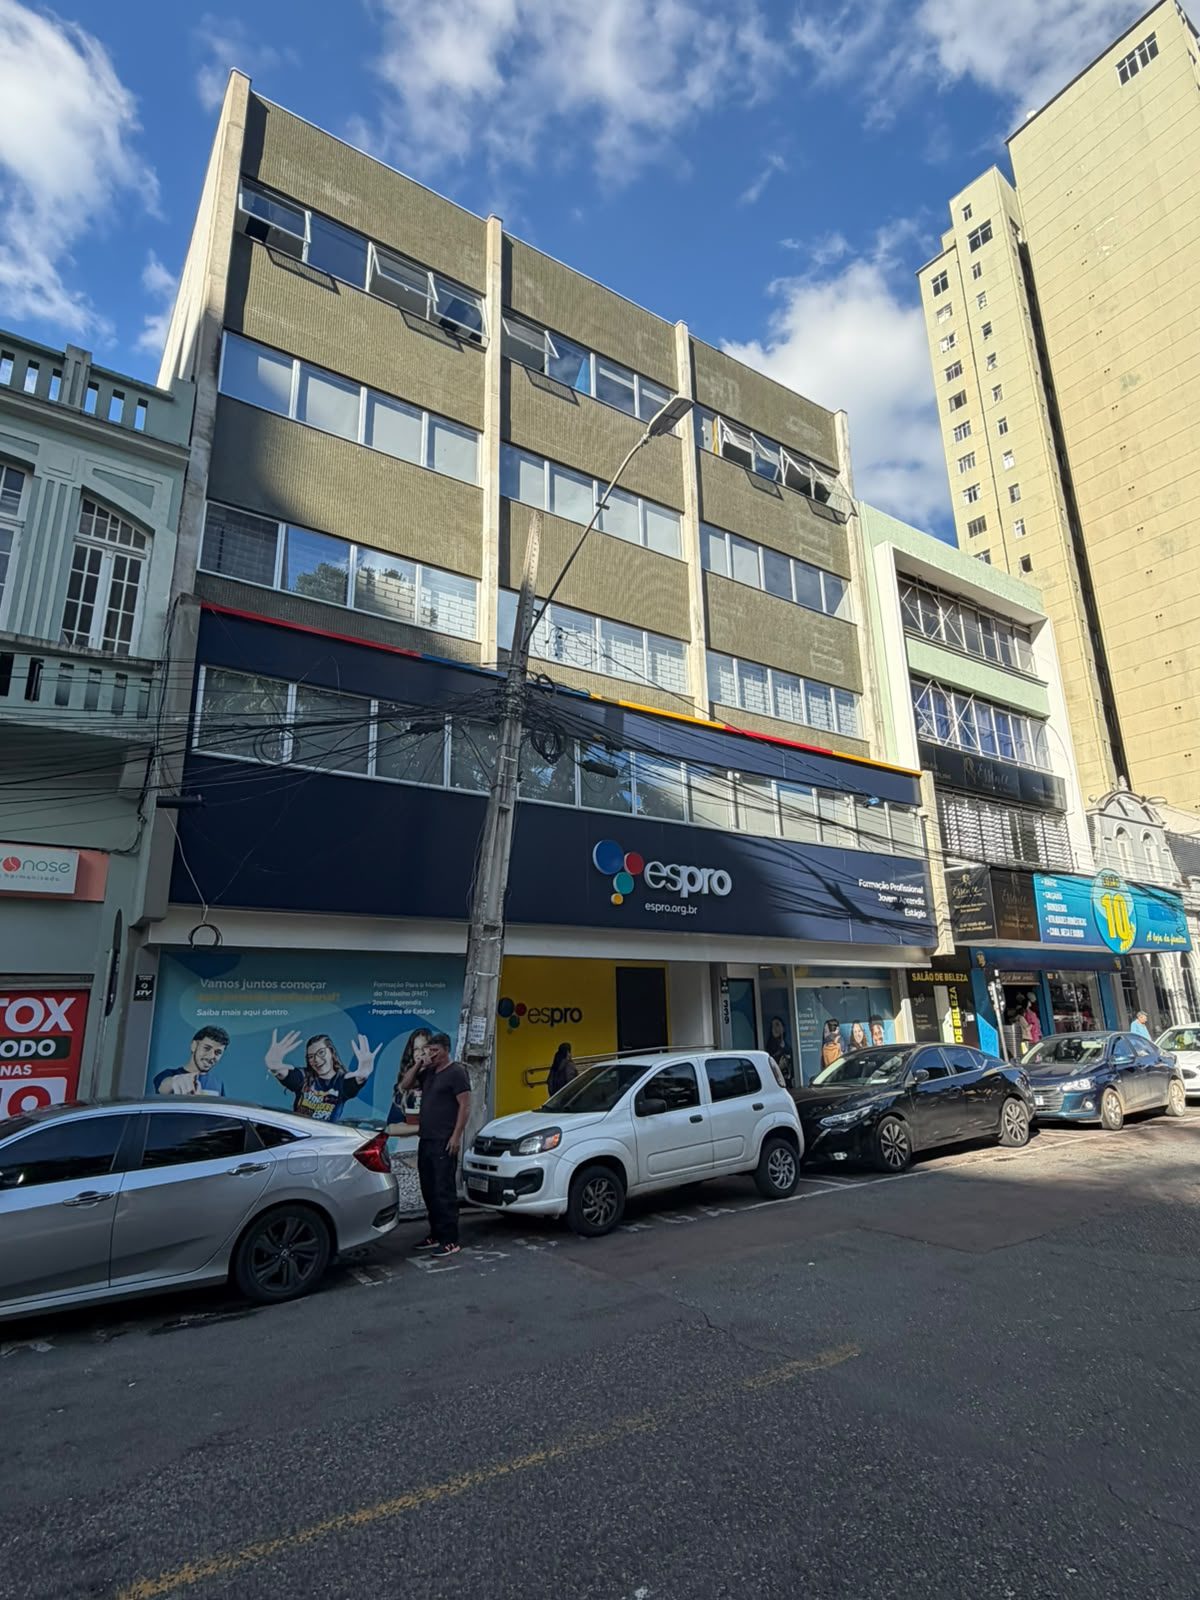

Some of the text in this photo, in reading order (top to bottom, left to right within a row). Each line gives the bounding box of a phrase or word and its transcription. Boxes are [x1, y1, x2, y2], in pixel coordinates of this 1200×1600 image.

[22, 859, 71, 874] nose
[643, 861, 732, 898] espro
[858, 878, 924, 894] Formação Profissional
[878, 893, 898, 903] Jovem
[644, 902, 698, 915] espro.org.br
[904, 908, 927, 919] Estágio
[911, 971, 969, 982] SALÃO DE BELEZA
[200, 978, 327, 991] Vamos juntos começar
[196, 1008, 220, 1016] Saiba
[242, 1009, 261, 1018] aqui
[372, 1008, 402, 1016] Programa
[527, 1007, 583, 1028] espro
